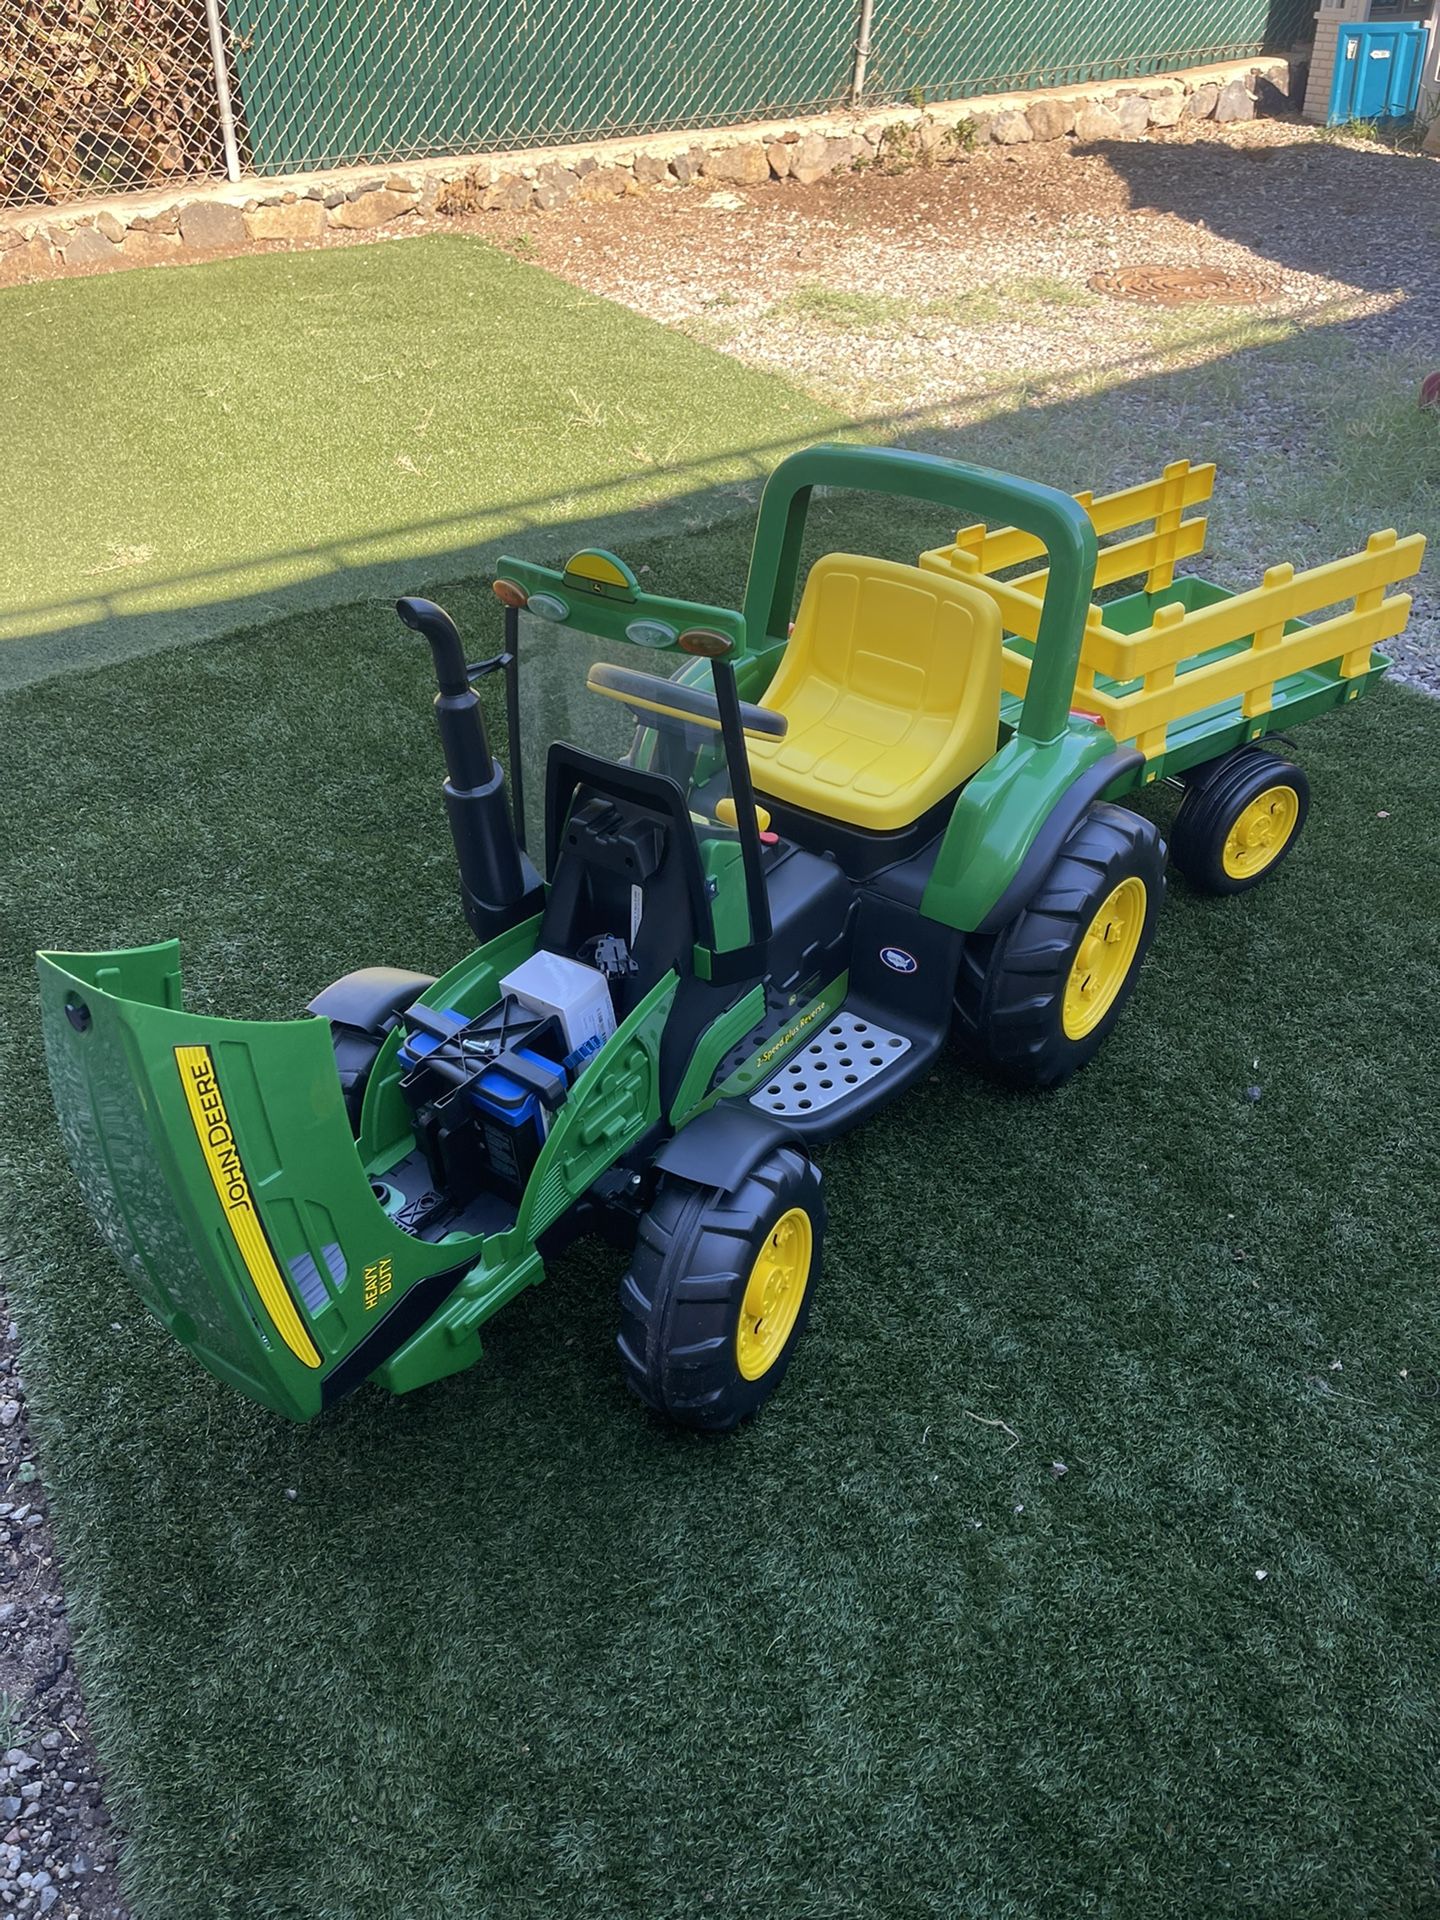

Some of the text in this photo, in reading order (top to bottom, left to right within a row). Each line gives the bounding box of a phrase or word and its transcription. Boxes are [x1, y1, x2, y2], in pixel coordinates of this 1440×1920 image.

[757, 1002, 825, 1068] 2-Speed plus Reverse
[191, 1061, 250, 1211] JOHN DEERE
[365, 1266, 378, 1310] HEAVY
[379, 1259, 392, 1294] DUTY
